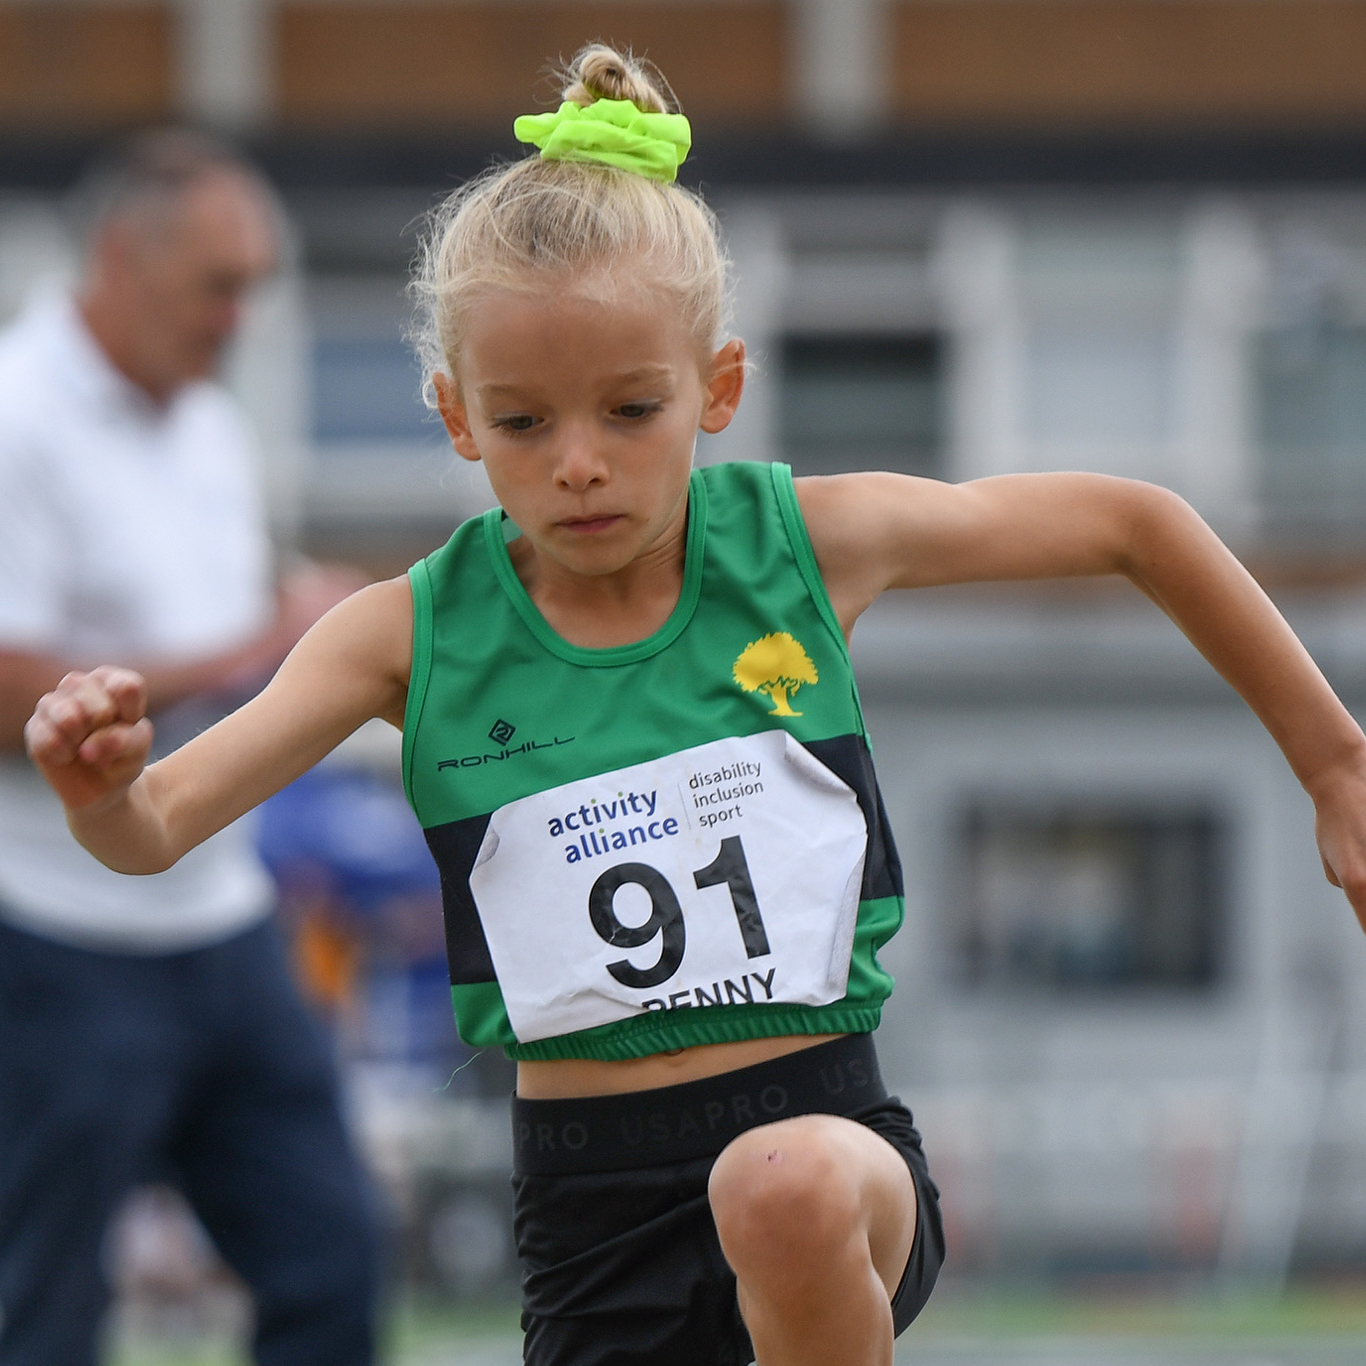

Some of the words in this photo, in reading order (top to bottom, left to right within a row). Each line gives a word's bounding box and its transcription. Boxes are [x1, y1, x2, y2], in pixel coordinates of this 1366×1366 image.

[437, 736, 575, 771] RONHILL
[688, 761, 762, 790] disability
[693, 781, 764, 809] inclusion
[547, 790, 658, 837] activity
[699, 804, 743, 828] sport
[565, 816, 679, 864] alliance
[588, 834, 771, 989] 91
